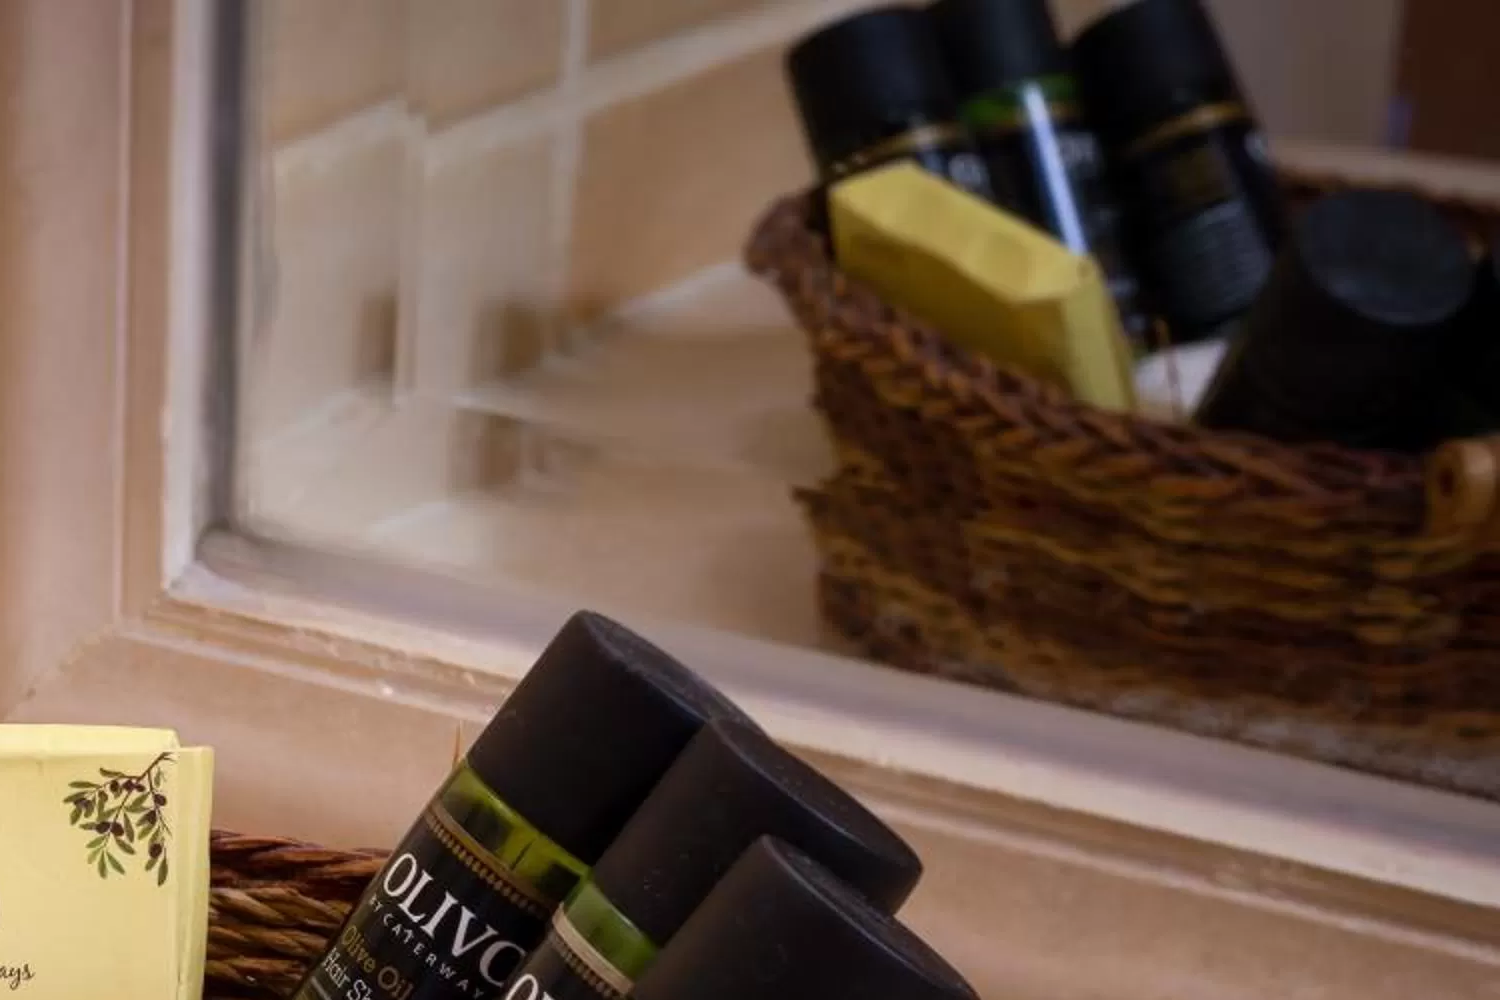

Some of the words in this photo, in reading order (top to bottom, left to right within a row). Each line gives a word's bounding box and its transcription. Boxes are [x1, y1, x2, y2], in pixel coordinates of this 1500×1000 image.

[341, 924, 377, 974] Olive
[383, 852, 528, 988] OLIVO
[322, 945, 352, 989] Hair
[382, 912, 485, 1000] CATERWAY
